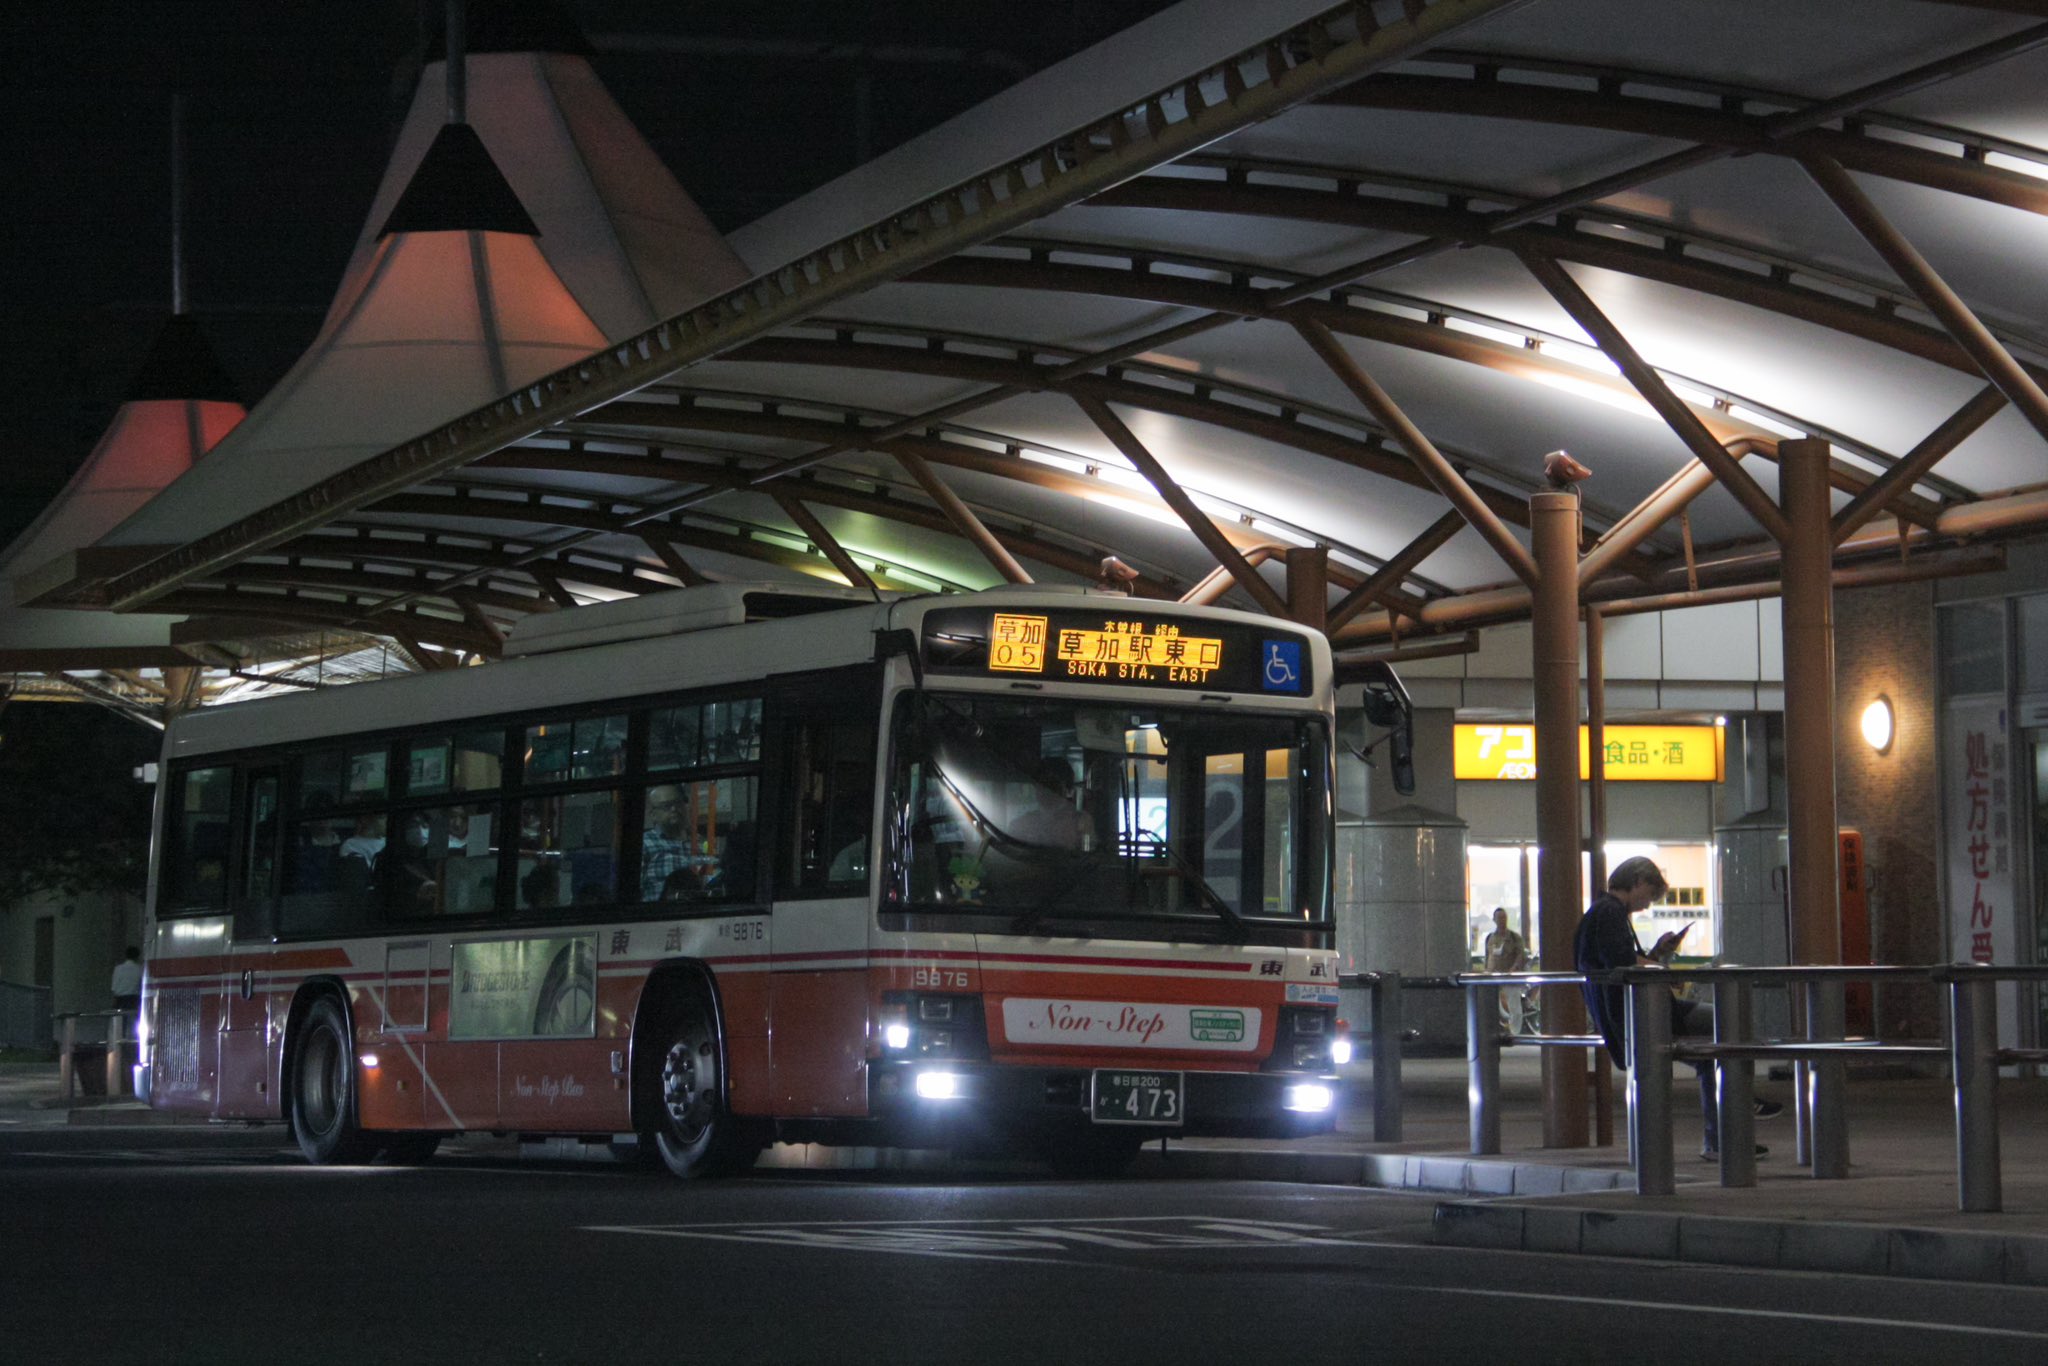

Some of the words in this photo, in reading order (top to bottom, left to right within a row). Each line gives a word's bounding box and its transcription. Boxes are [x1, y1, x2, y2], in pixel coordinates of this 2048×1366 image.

[997, 620, 1041, 645] 草加
[996, 644, 1037, 666] 05
[1061, 631, 1220, 665] 草加駅東口
[1118, 663, 1155, 680] STA.
[1169, 667, 1210, 683] EAST
[733, 922, 763, 941] 9876
[916, 970, 968, 987] 9876
[1029, 1003, 1166, 1043] Non-Step
